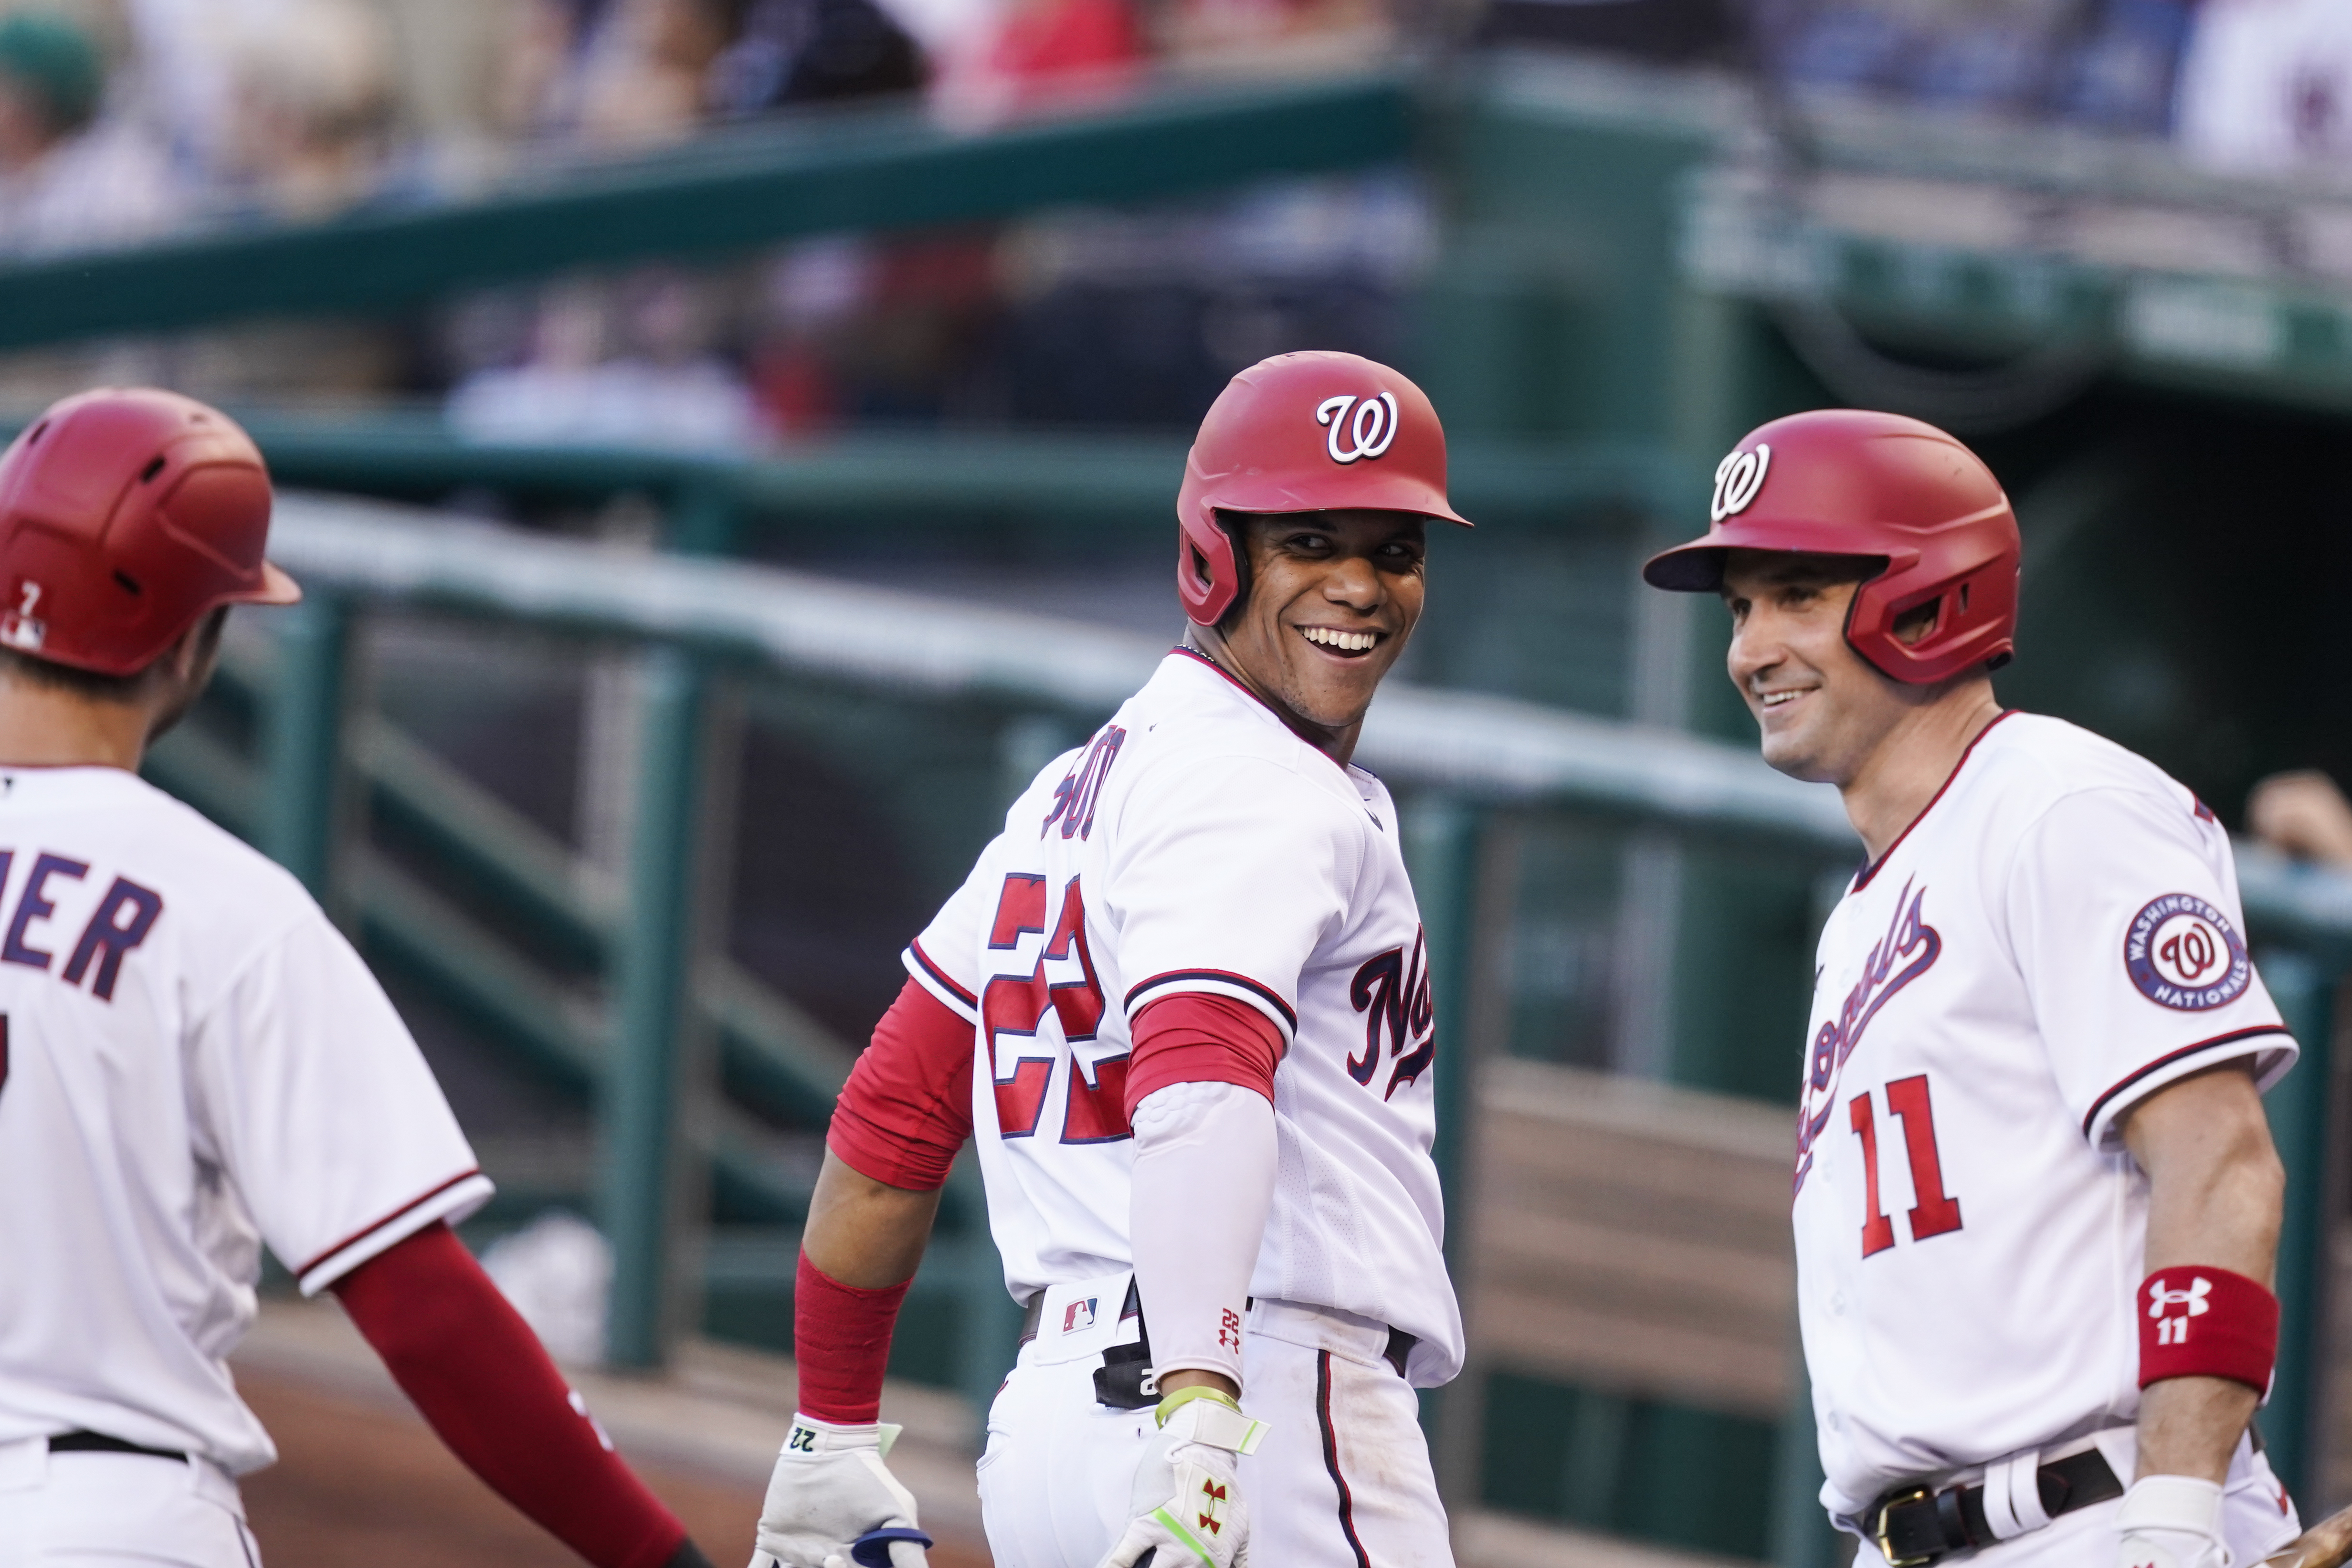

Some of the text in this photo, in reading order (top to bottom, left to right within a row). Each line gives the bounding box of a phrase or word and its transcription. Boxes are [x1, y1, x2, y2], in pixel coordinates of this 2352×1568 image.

[2129, 896, 2231, 961] WASHINGTON
[982, 873, 1135, 1144] 22
[2154, 958, 2247, 1007] NATIONALS
[1848, 1073, 1963, 1259] 11
[1223, 1307, 1239, 1336] 22
[2156, 1315, 2188, 1346] 11
